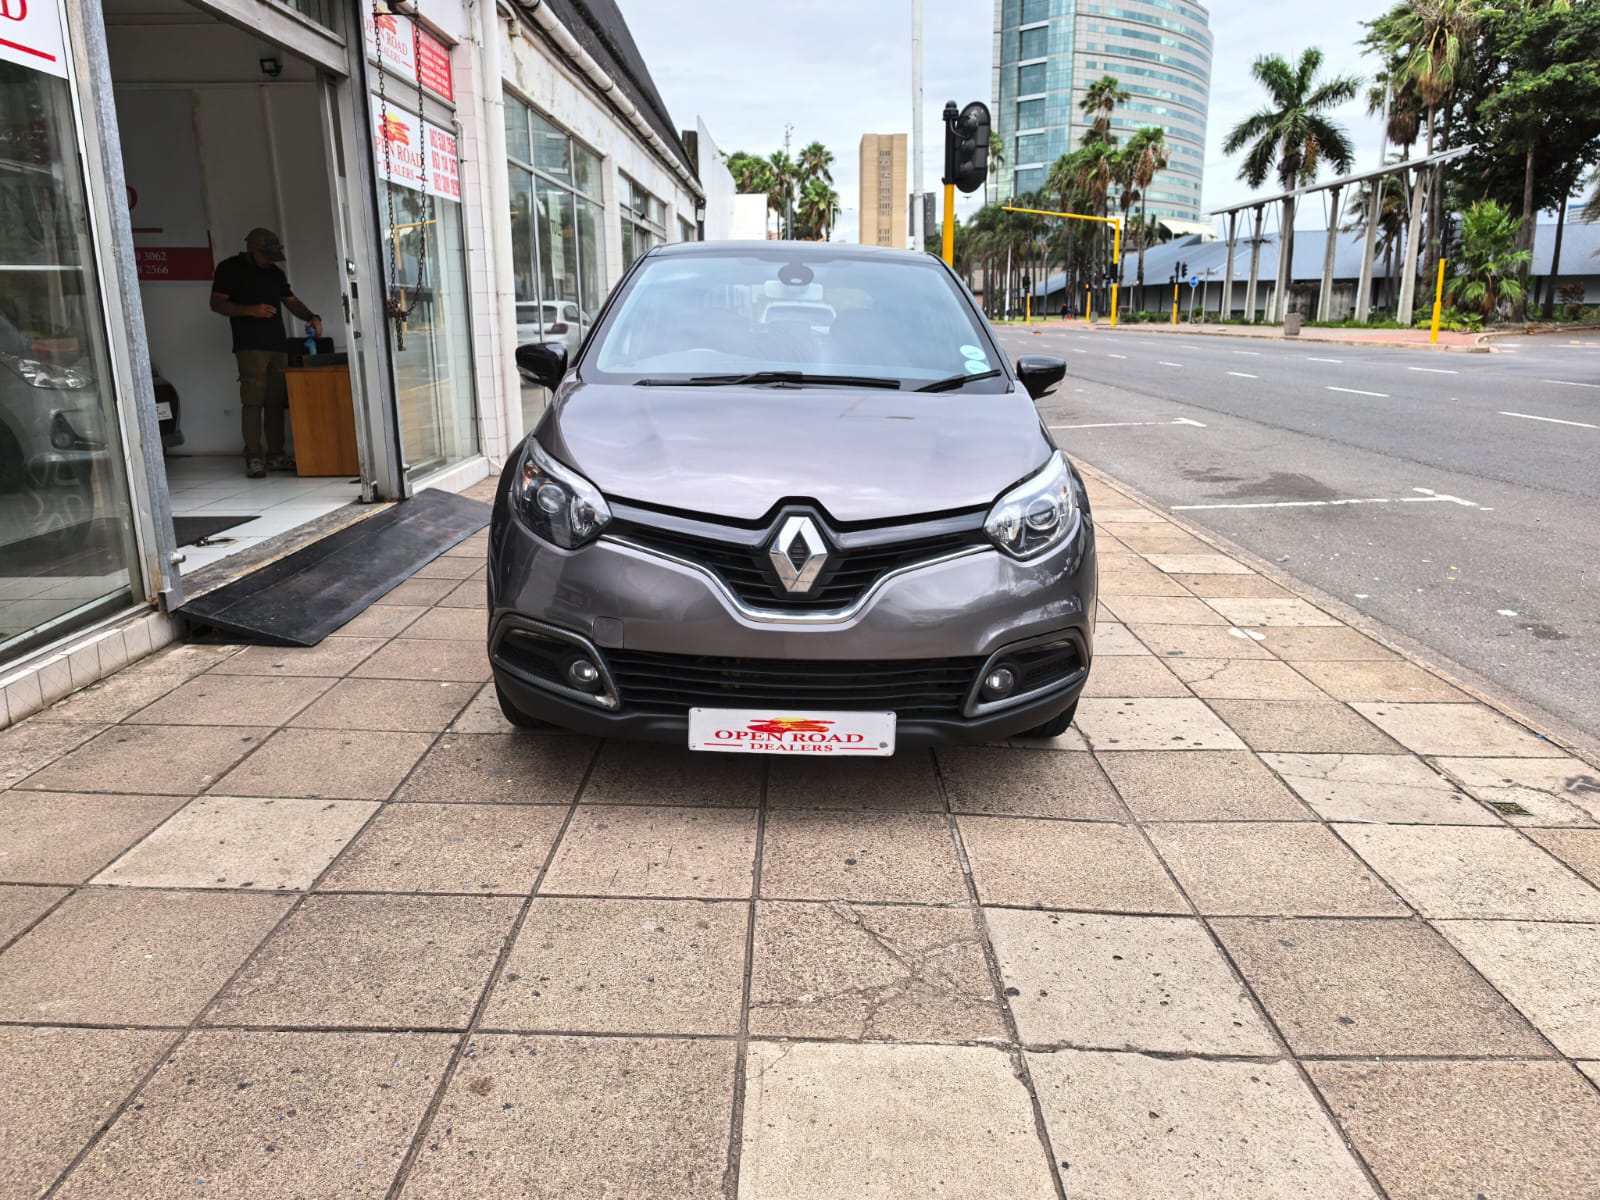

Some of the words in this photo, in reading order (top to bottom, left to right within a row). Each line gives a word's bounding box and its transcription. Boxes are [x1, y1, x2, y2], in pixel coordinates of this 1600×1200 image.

[387, 32, 408, 57] ROAD
[714, 730, 784, 743] OPEN
[792, 732, 865, 744] ROAD
[750, 742, 834, 753] DEALERS
